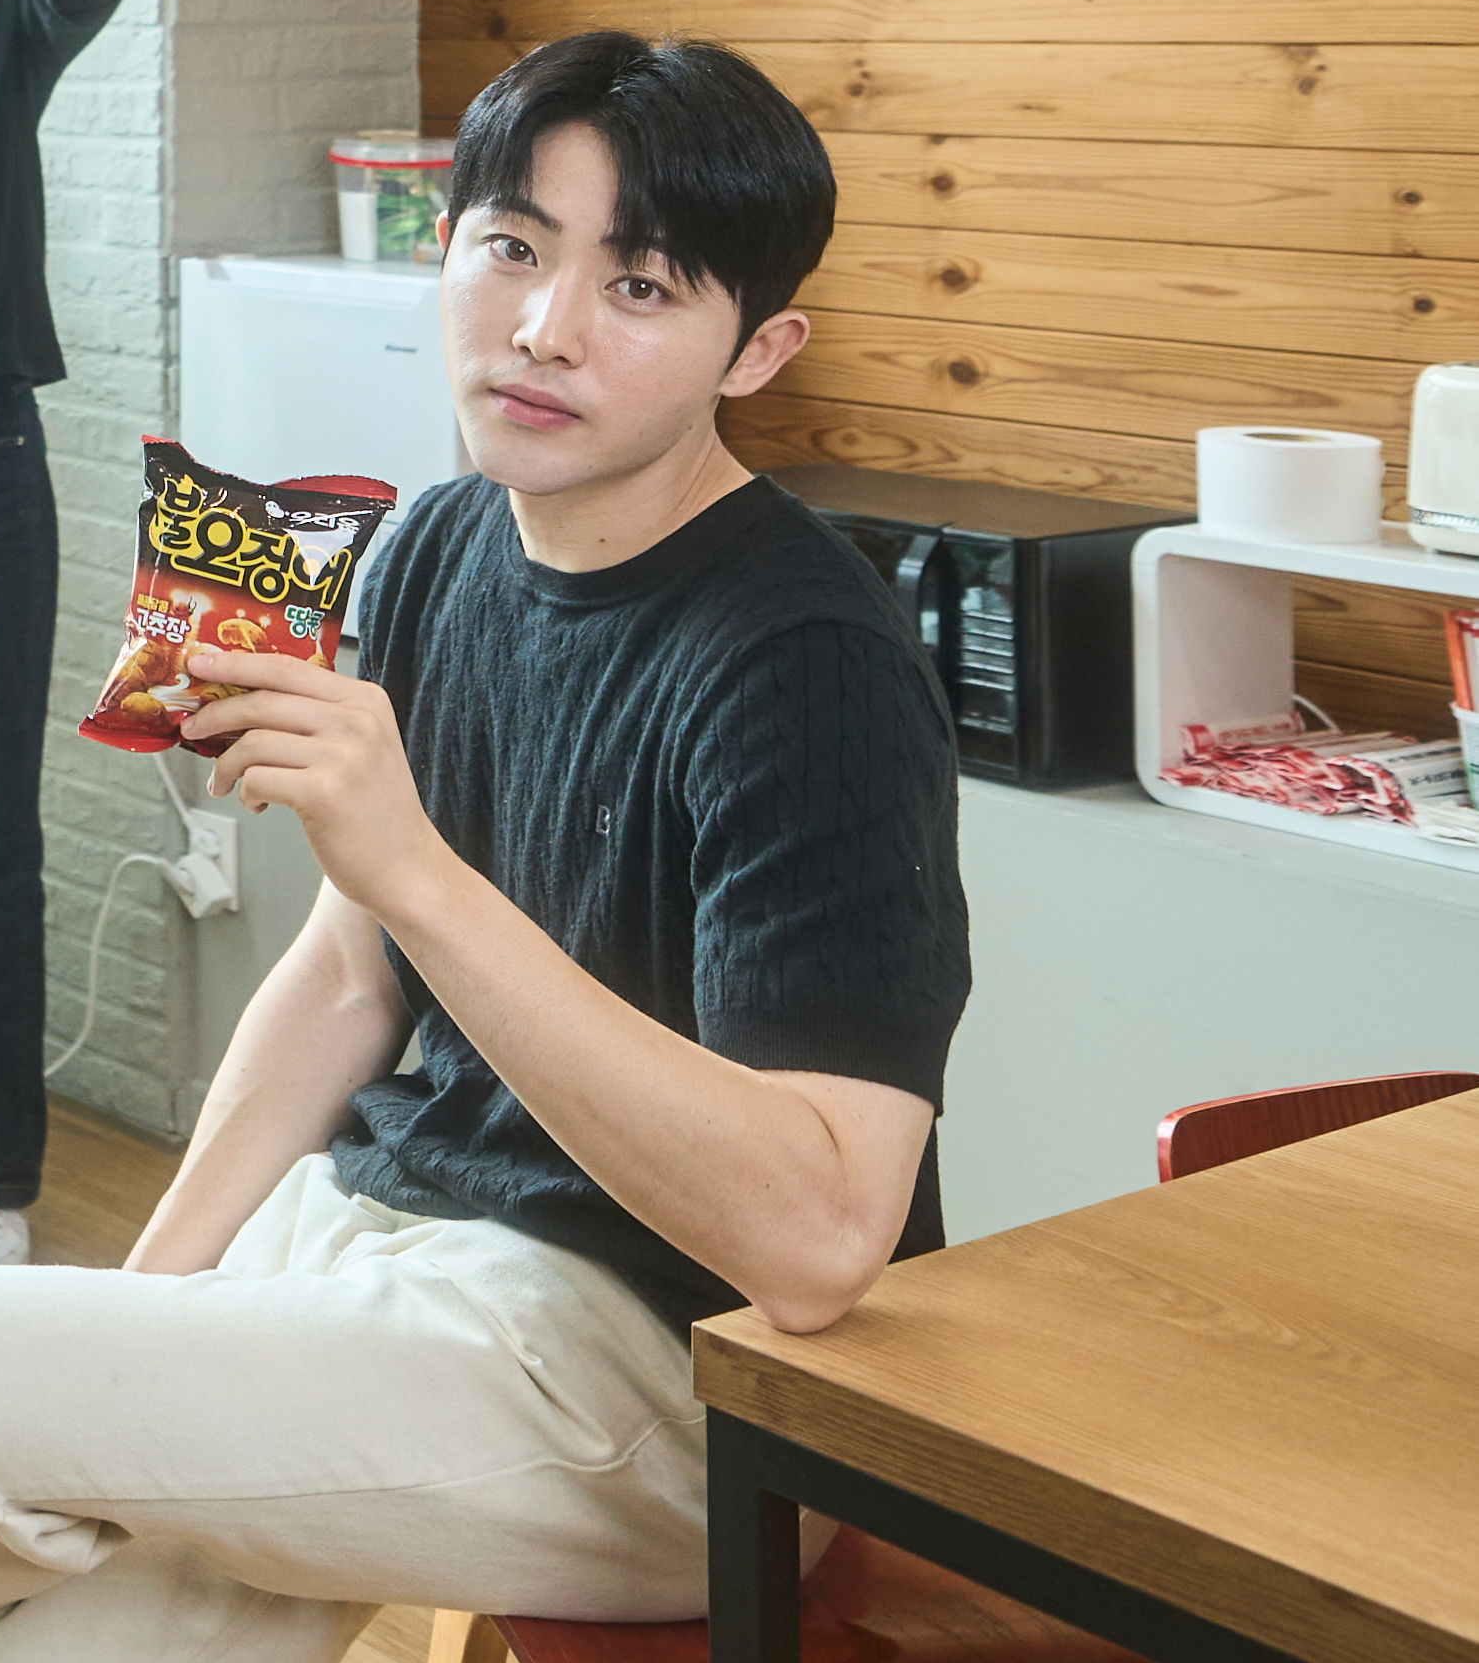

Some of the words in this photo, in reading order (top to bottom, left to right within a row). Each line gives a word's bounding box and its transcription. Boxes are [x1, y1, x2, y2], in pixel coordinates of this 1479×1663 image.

[148, 473, 353, 610] 불오징어
[135, 607, 191, 644] 고추장
[284, 605, 326, 640] 땅콩
